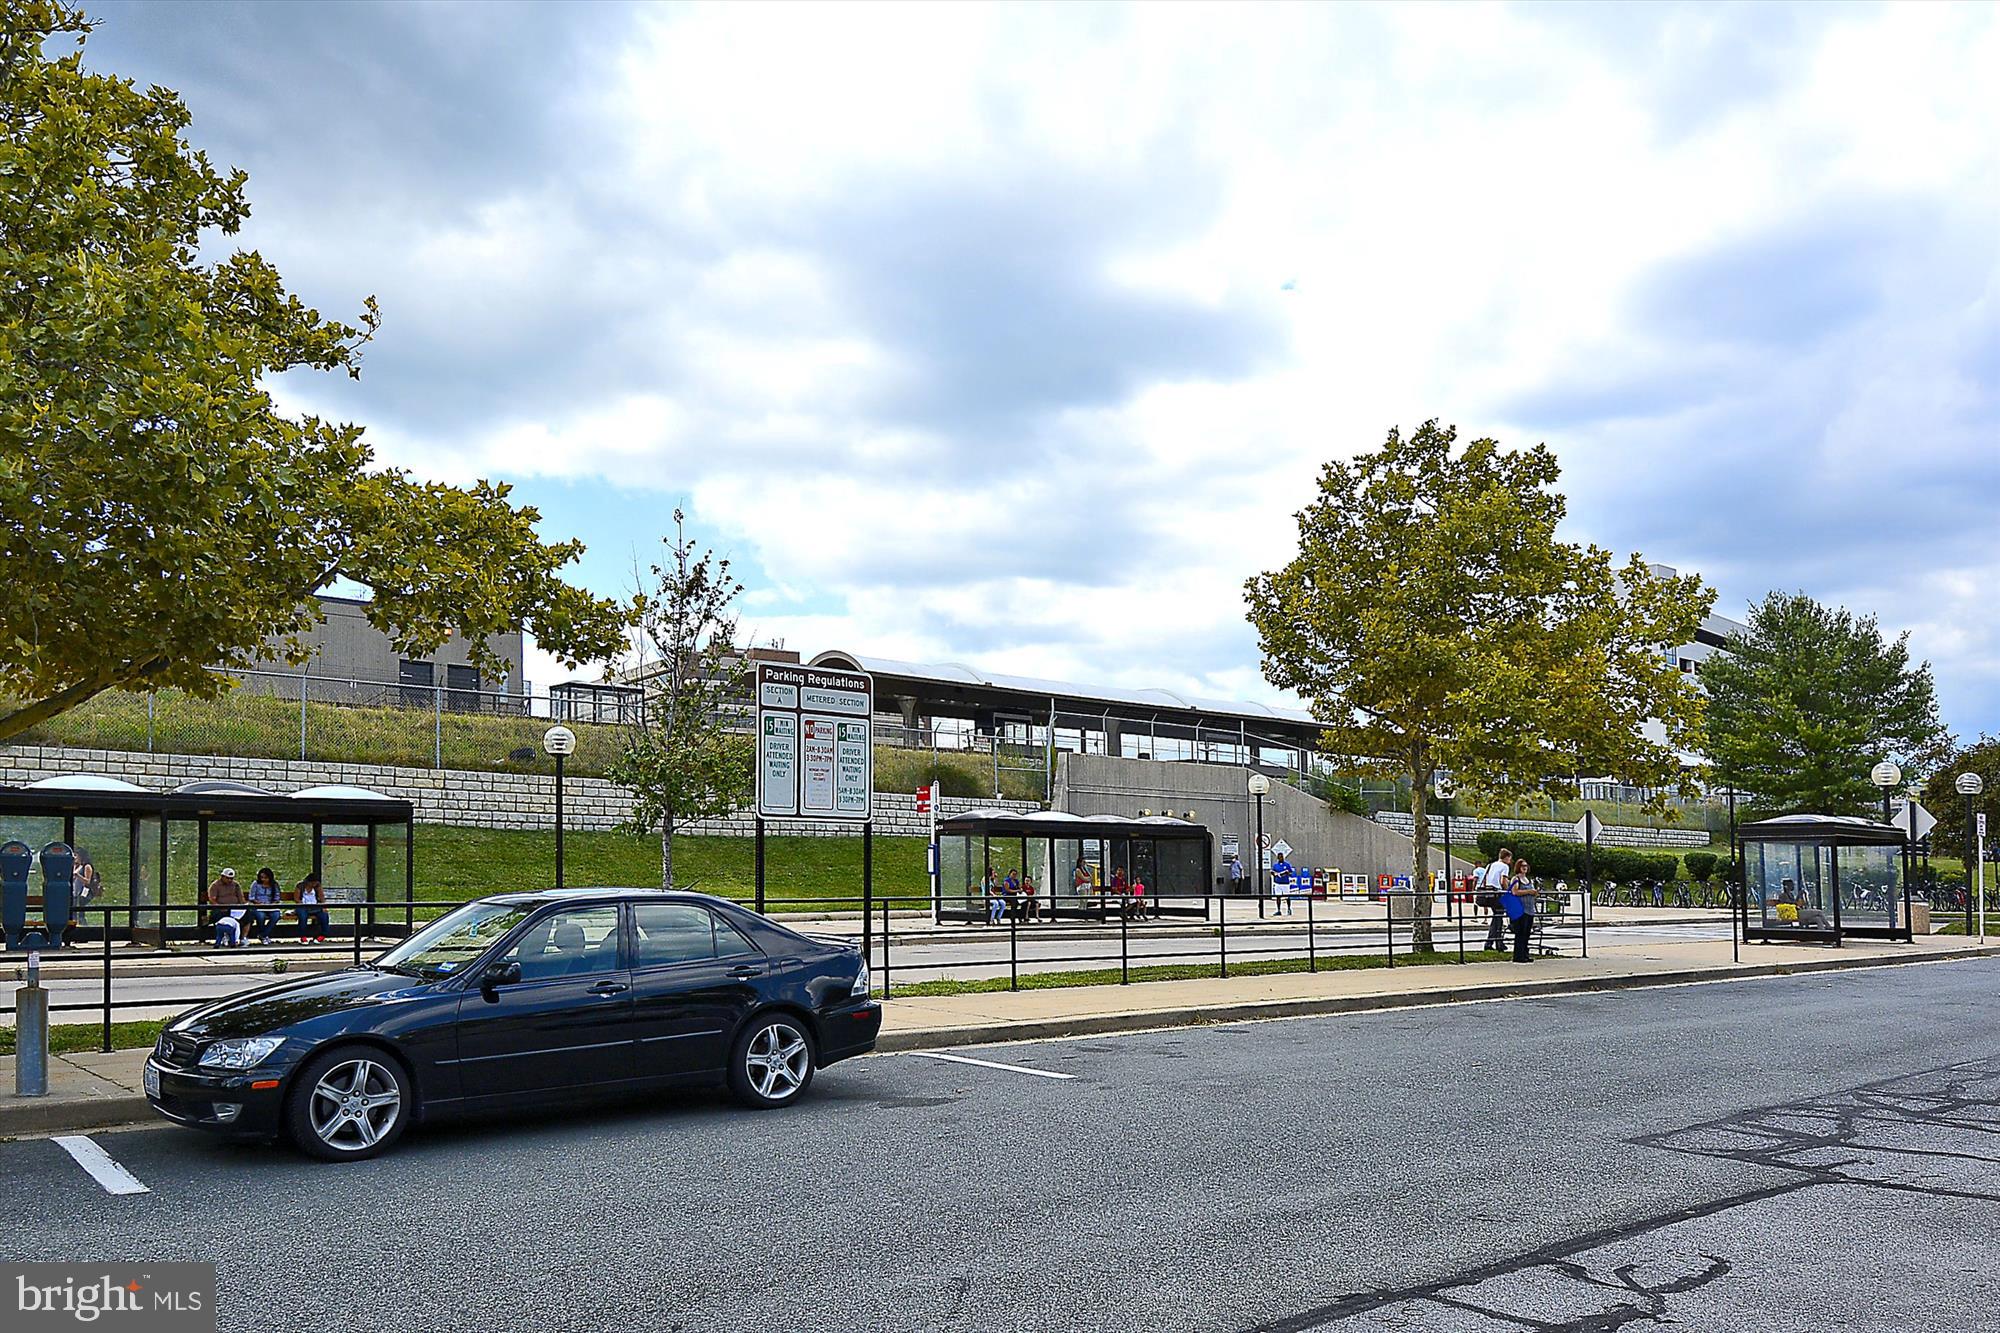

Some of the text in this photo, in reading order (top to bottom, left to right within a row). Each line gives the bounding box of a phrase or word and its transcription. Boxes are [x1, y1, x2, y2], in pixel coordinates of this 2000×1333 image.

[765, 668, 865, 689] Parking Regulations
[766, 686, 793, 695] SECTION
[806, 695, 864, 708] METERED SECTION
[766, 720, 774, 732] 15
[838, 726, 846, 738] 15
[769, 742, 790, 751] DRIVER
[766, 751, 793, 760] ATTENDED
[842, 747, 861, 756] DRIVER
[769, 760, 790, 769] WAITING
[839, 756, 864, 765] ATTENDED
[772, 769, 786, 777] ONLY
[842, 765, 862, 774] WAITING
